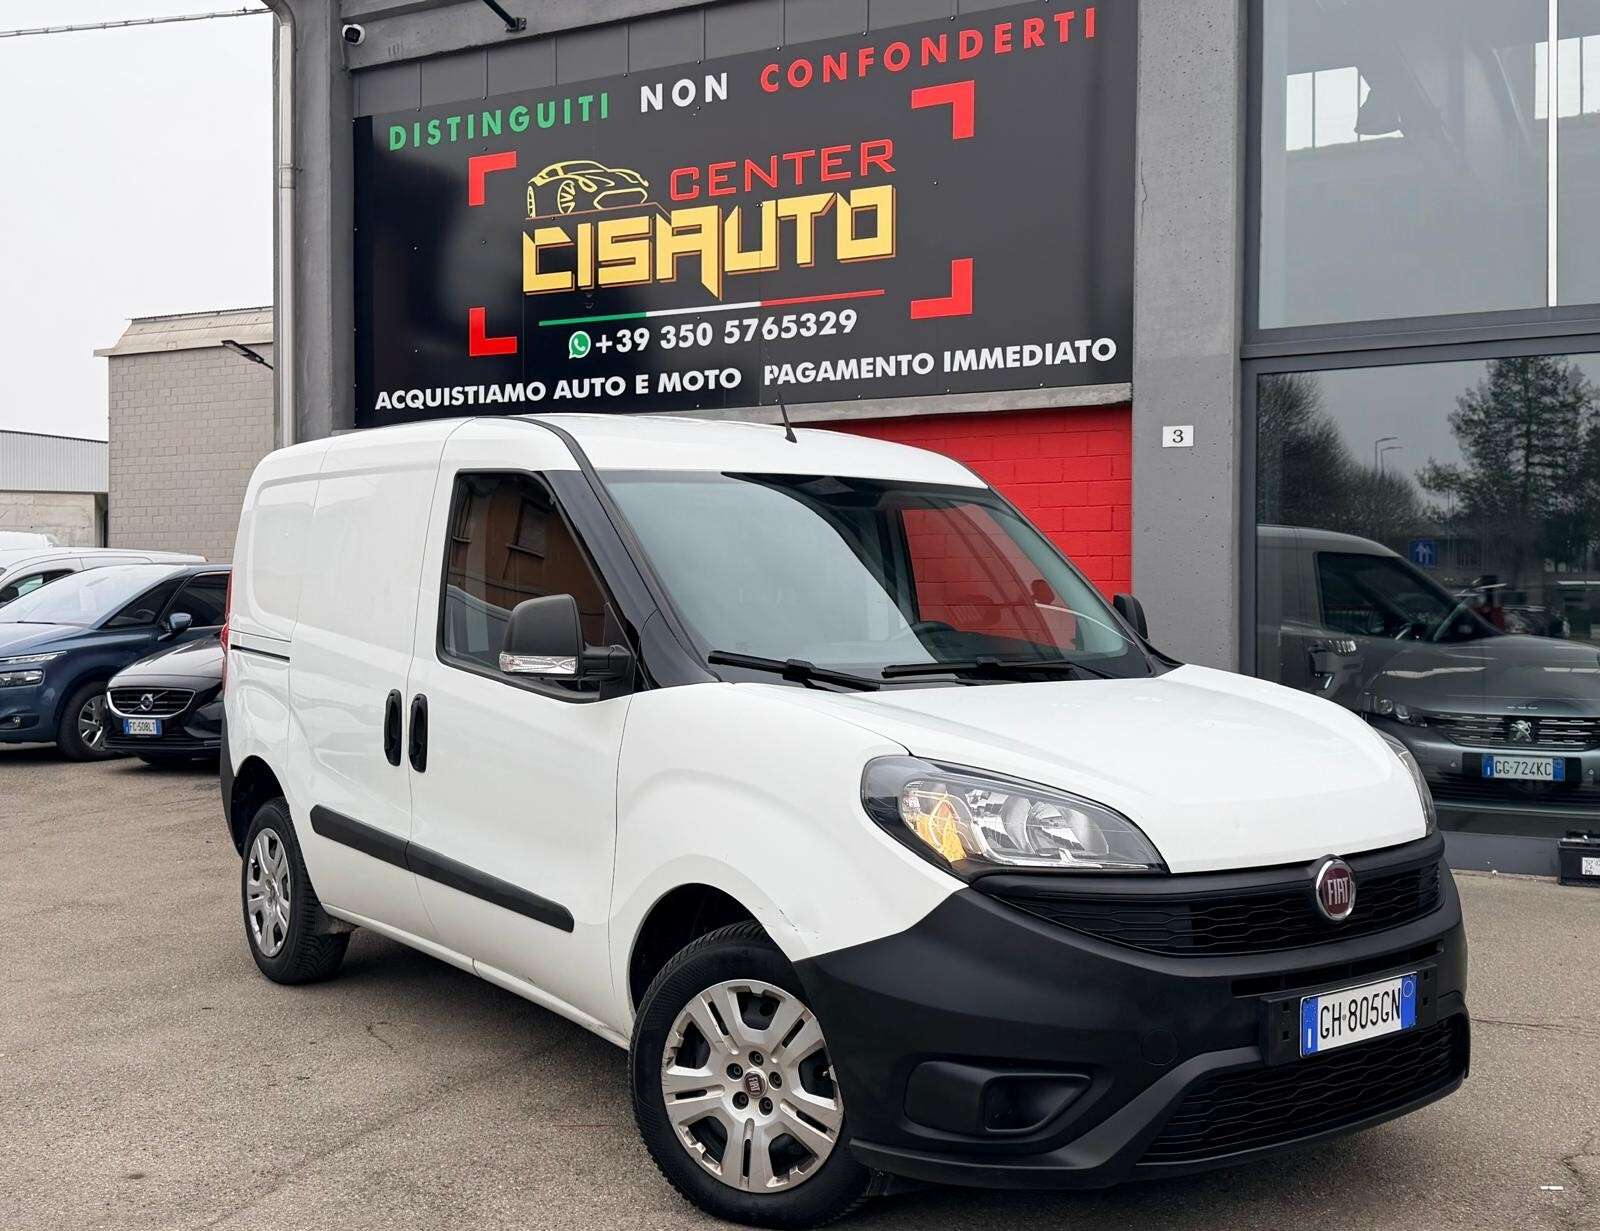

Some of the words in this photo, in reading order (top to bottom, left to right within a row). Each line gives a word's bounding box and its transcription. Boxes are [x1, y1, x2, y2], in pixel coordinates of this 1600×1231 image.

[389, 92, 609, 151] DISTINGUITI
[640, 72, 728, 113] NON
[759, 7, 1096, 93] CONFONDERTI
[670, 138, 896, 201] CENTER
[522, 184, 896, 301] CISAUTO
[595, 327, 650, 354] +39
[660, 322, 713, 350] 350
[723, 309, 858, 345] 5765329
[375, 381, 546, 411] ACQUISTIAMO
[553, 375, 626, 400] AUTO
[635, 373, 649, 395] E
[657, 367, 742, 393] MOTO
[764, 351, 935, 386] PAGAMENTO
[943, 337, 1117, 373] IMMEDIATO
[1172, 429, 1184, 444] 3
[1327, 876, 1349, 906] FIAT
